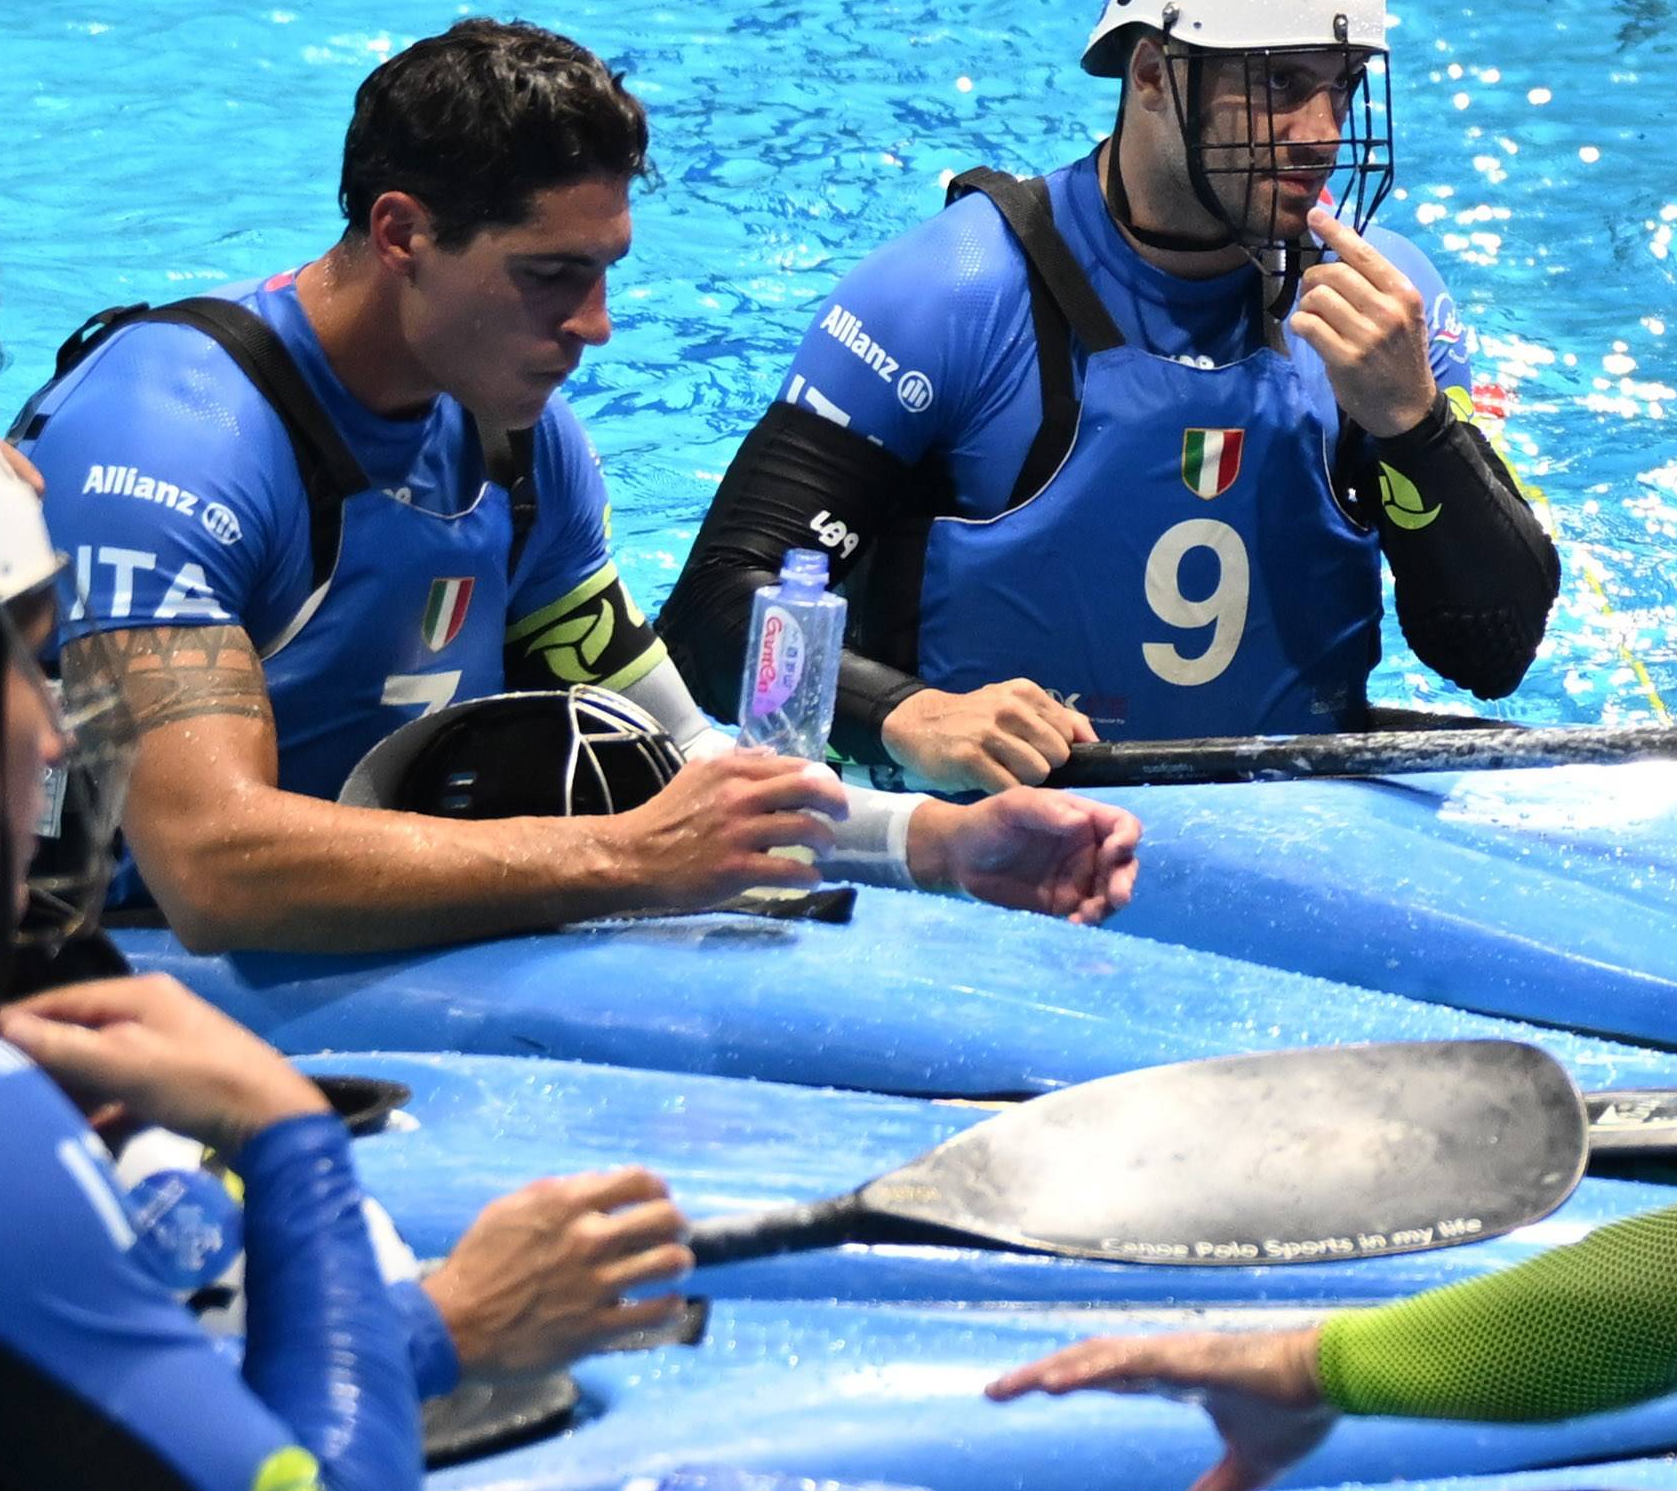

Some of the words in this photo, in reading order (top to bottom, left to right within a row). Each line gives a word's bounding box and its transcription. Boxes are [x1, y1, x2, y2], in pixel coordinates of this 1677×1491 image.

[820, 304, 901, 383] Allianz
[82, 465, 199, 516] Allianz
[69, 545, 232, 621] ITA
[1142, 518, 1250, 687] 9
[1101, 1237, 1190, 1258] Canoe
[1195, 1241, 1259, 1259] Polo
[1262, 1234, 1354, 1260] Sports
[1358, 1232, 1387, 1249] in
[1391, 1226, 1433, 1245] my
[1437, 1216, 1482, 1237] life
